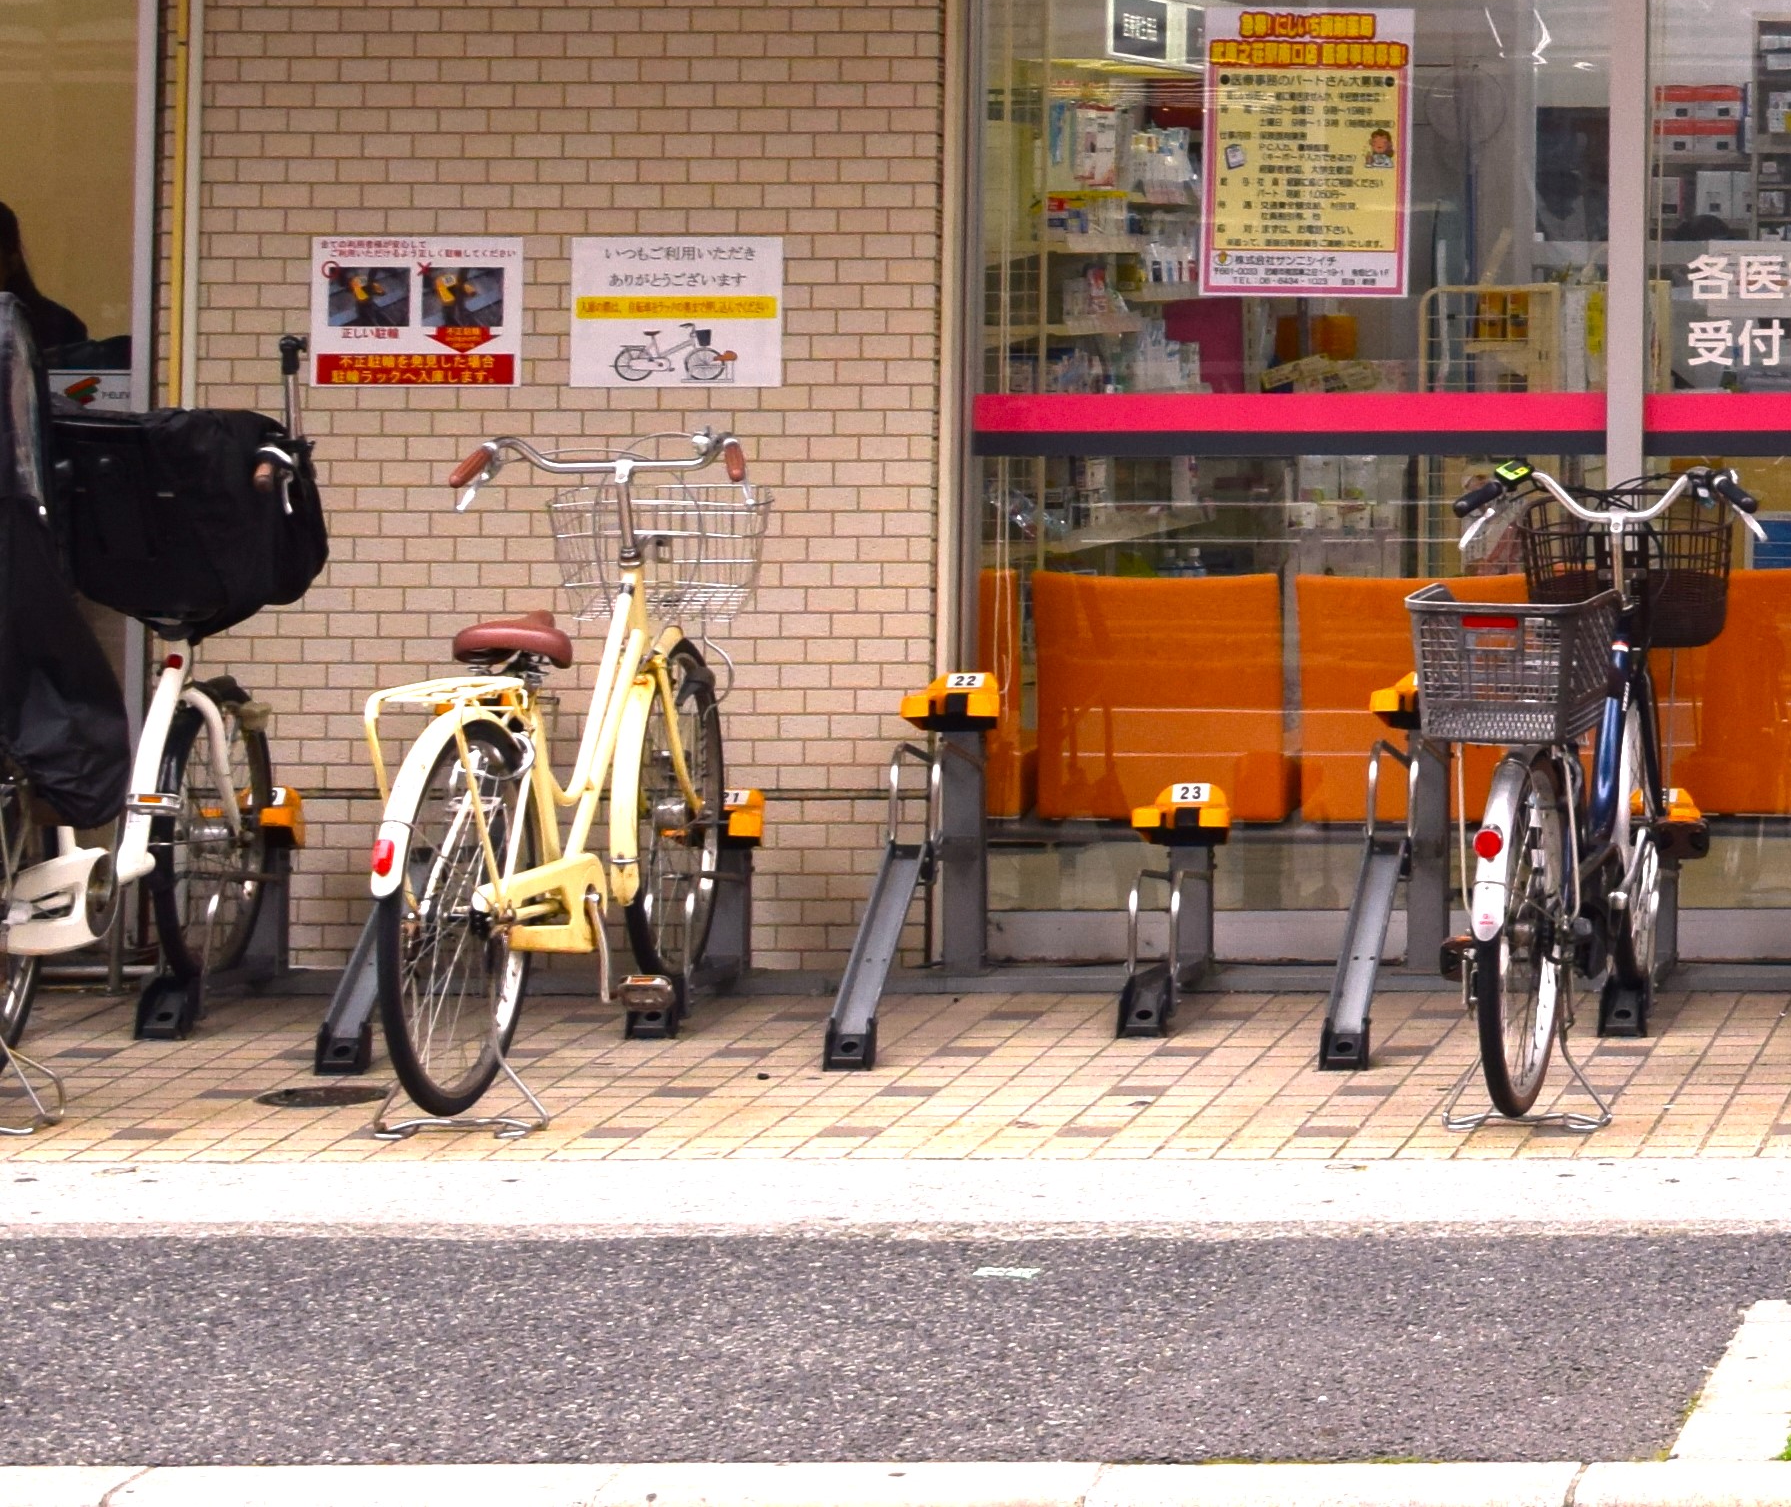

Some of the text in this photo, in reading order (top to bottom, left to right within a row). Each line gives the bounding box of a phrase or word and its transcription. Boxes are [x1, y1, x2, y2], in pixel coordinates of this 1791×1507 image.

[604, 246, 757, 261] いつもご利用いただき
[608, 272, 747, 288] ありがとうございます
[341, 328, 399, 339] 正しい駐輪
[338, 354, 496, 369] 不正駐輪を発見した場合
[331, 370, 496, 384] 駐輪ラックへ入庫します。
[954, 675, 977, 687] 22
[1180, 785, 1202, 800] 23
